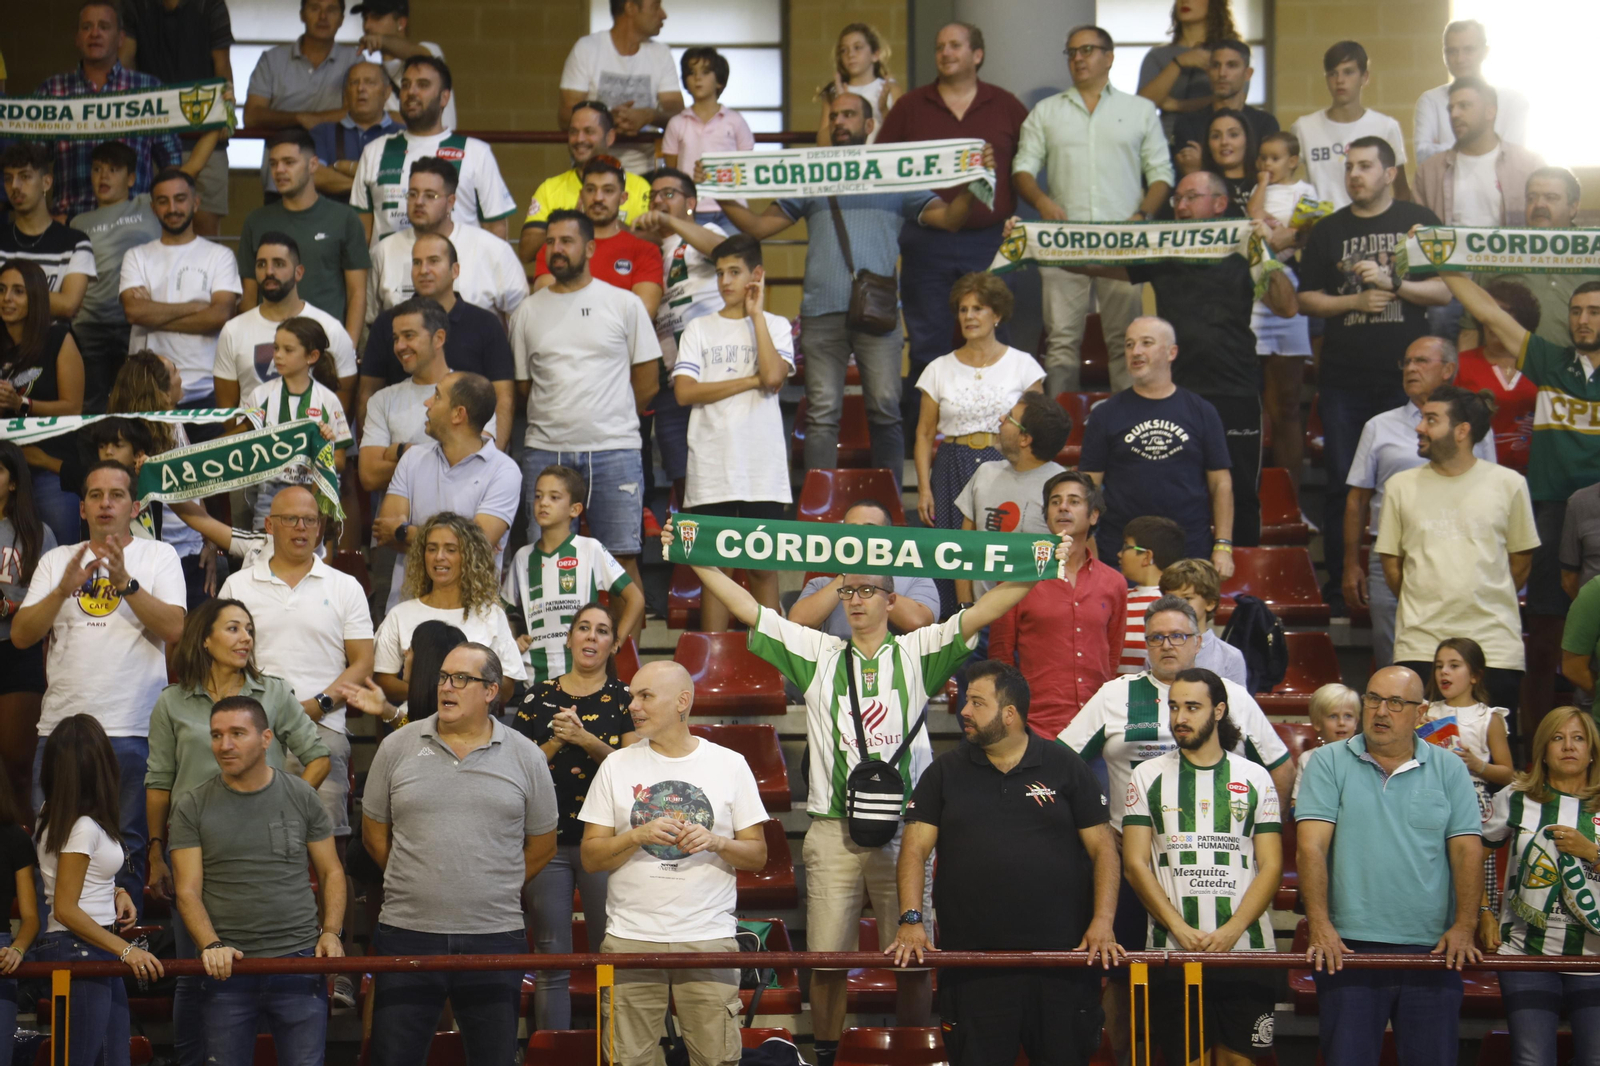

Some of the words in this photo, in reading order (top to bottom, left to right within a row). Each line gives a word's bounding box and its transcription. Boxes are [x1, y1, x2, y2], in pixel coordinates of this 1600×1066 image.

[82, 98, 170, 121] FUTSAL
[9, 121, 72, 131] PATRIMONIO
[77, 121, 89, 130] DE
[93, 121, 106, 130] LA
[111, 116, 170, 129] HUMANIDAD
[807, 150, 841, 159] DESDE
[754, 159, 883, 185] CÓRDOBA
[897, 154, 943, 178] C.F.
[803, 186, 815, 195] EL
[1037, 228, 1149, 249] CÓRDOBA
[1158, 227, 1242, 248] FUTSAL
[1466, 230, 1600, 255] CÓRDOBA
[1087, 248, 1147, 257] PATRIMONIO
[1124, 419, 1189, 443] QUIKSILVER
[714, 525, 924, 568] CÓRDOBA
[89, 602, 110, 610] CAFE
[546, 631, 568, 639] CÓRDO
[841, 732, 902, 749] CaaSur
